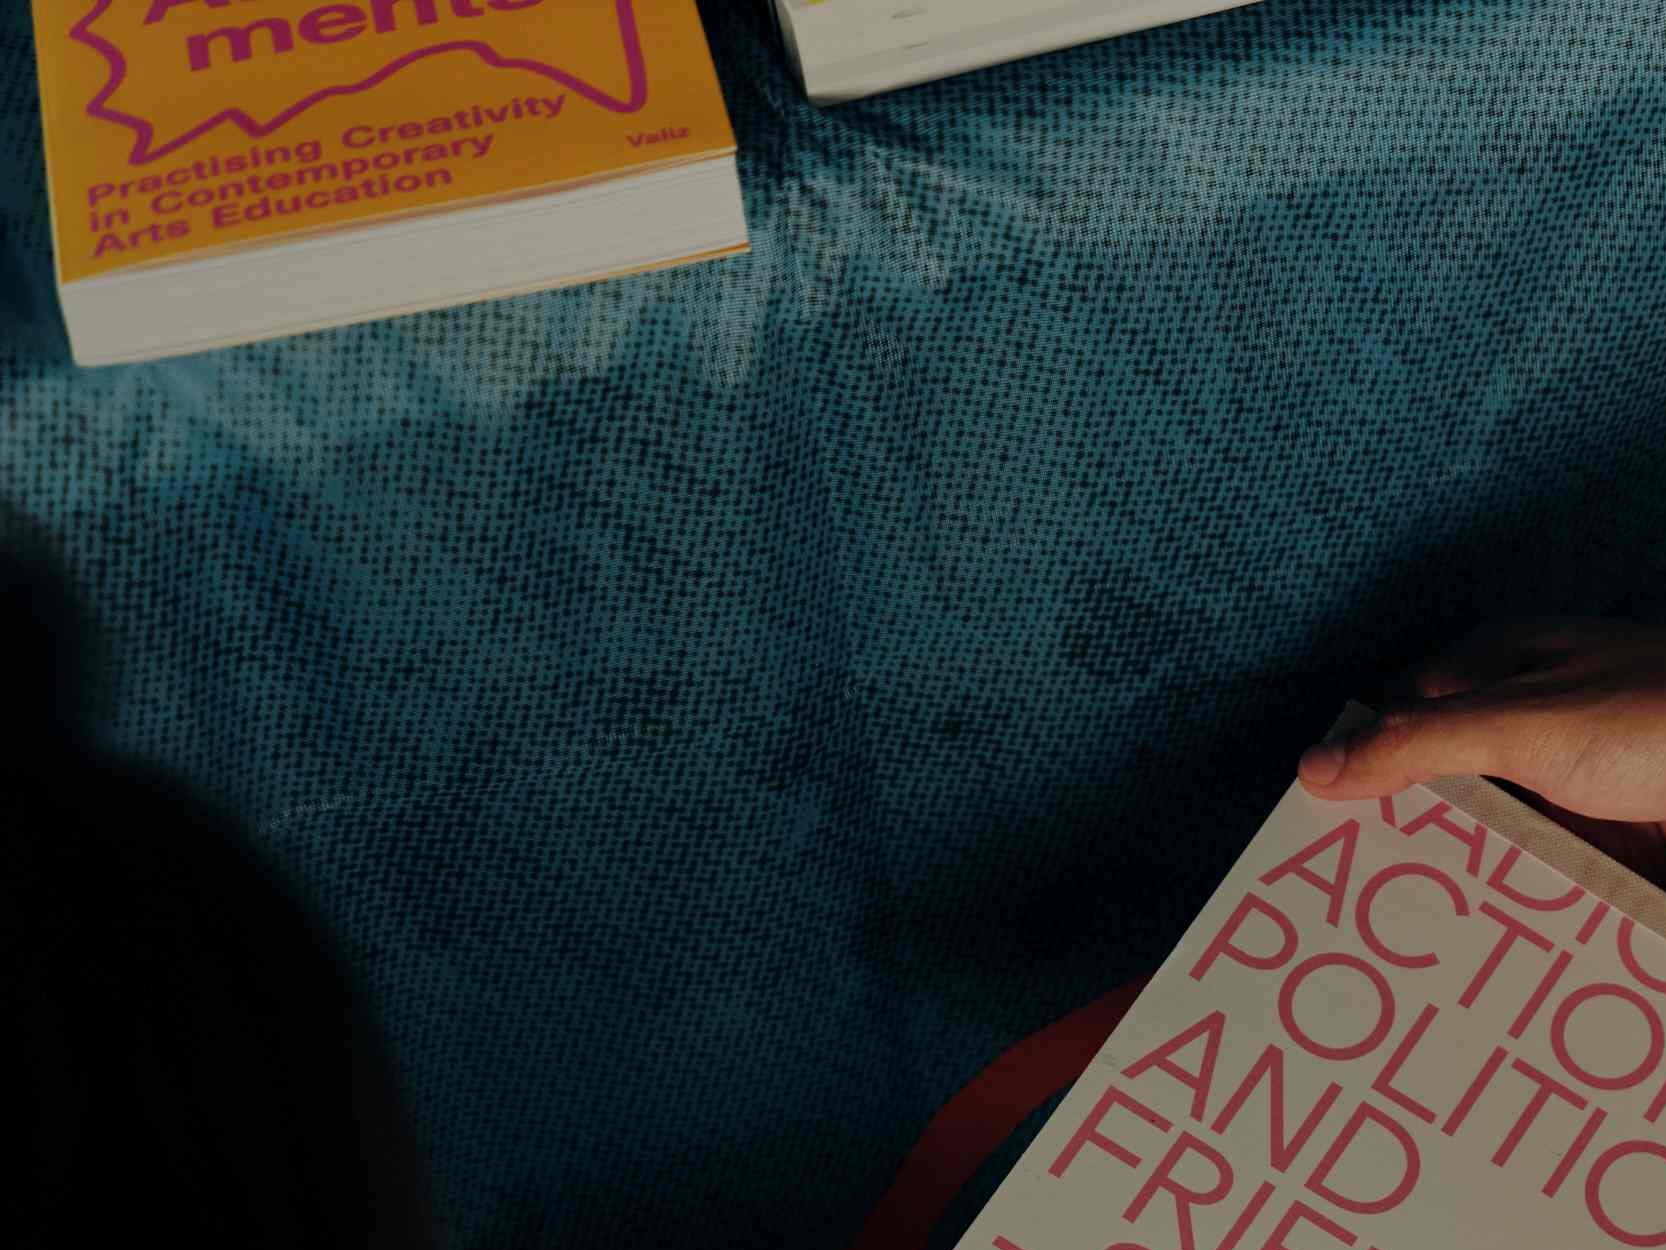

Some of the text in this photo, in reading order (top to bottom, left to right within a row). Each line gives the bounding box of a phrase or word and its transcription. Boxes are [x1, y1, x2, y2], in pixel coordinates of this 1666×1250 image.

[186, 0, 544, 72] men
[87, 94, 567, 207] Practising Creativity
[89, 131, 496, 233] in Contemporary
[626, 125, 690, 148] Valiz
[92, 165, 453, 258] Arts Education
[1124, 1012, 1420, 1214] AND
